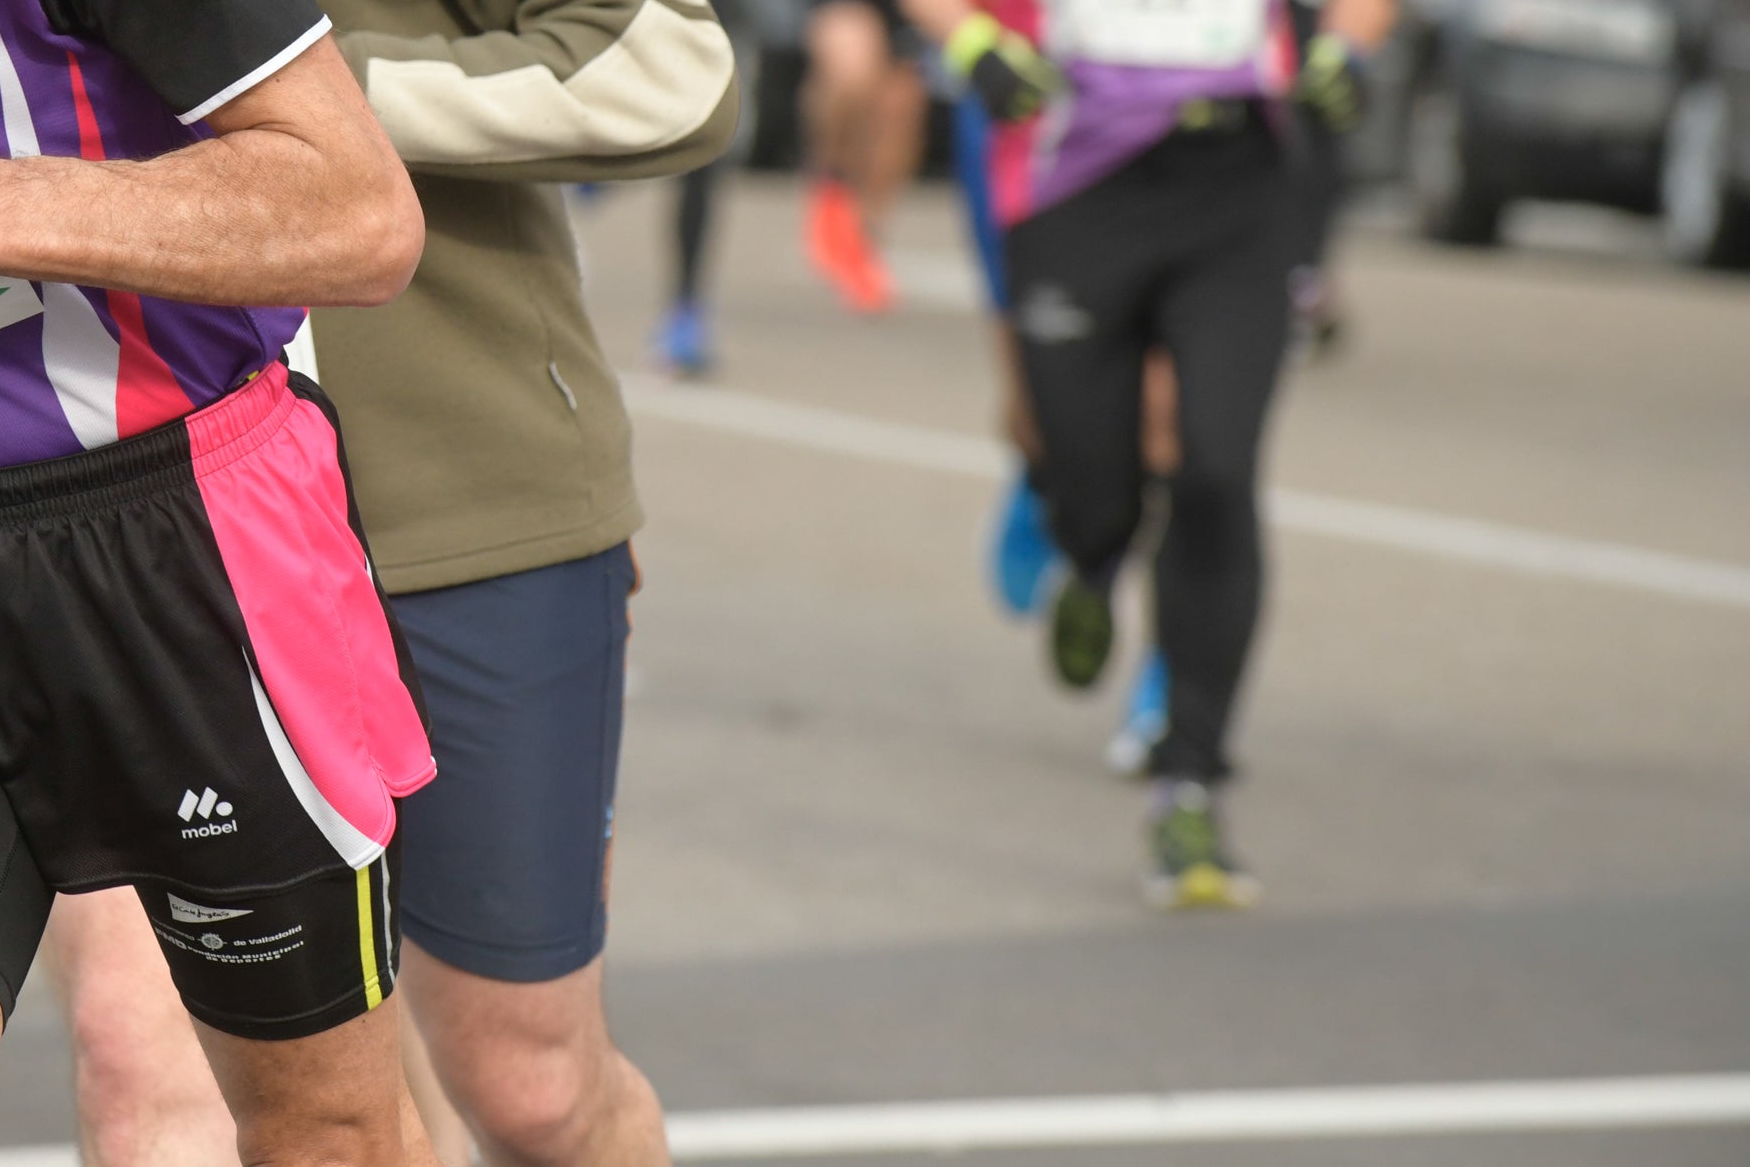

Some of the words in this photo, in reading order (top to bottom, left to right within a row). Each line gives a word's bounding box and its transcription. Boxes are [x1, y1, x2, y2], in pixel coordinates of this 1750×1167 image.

[181, 819, 238, 839] mobel
[233, 939, 246, 947] de
[248, 925, 303, 946] Valladolid
